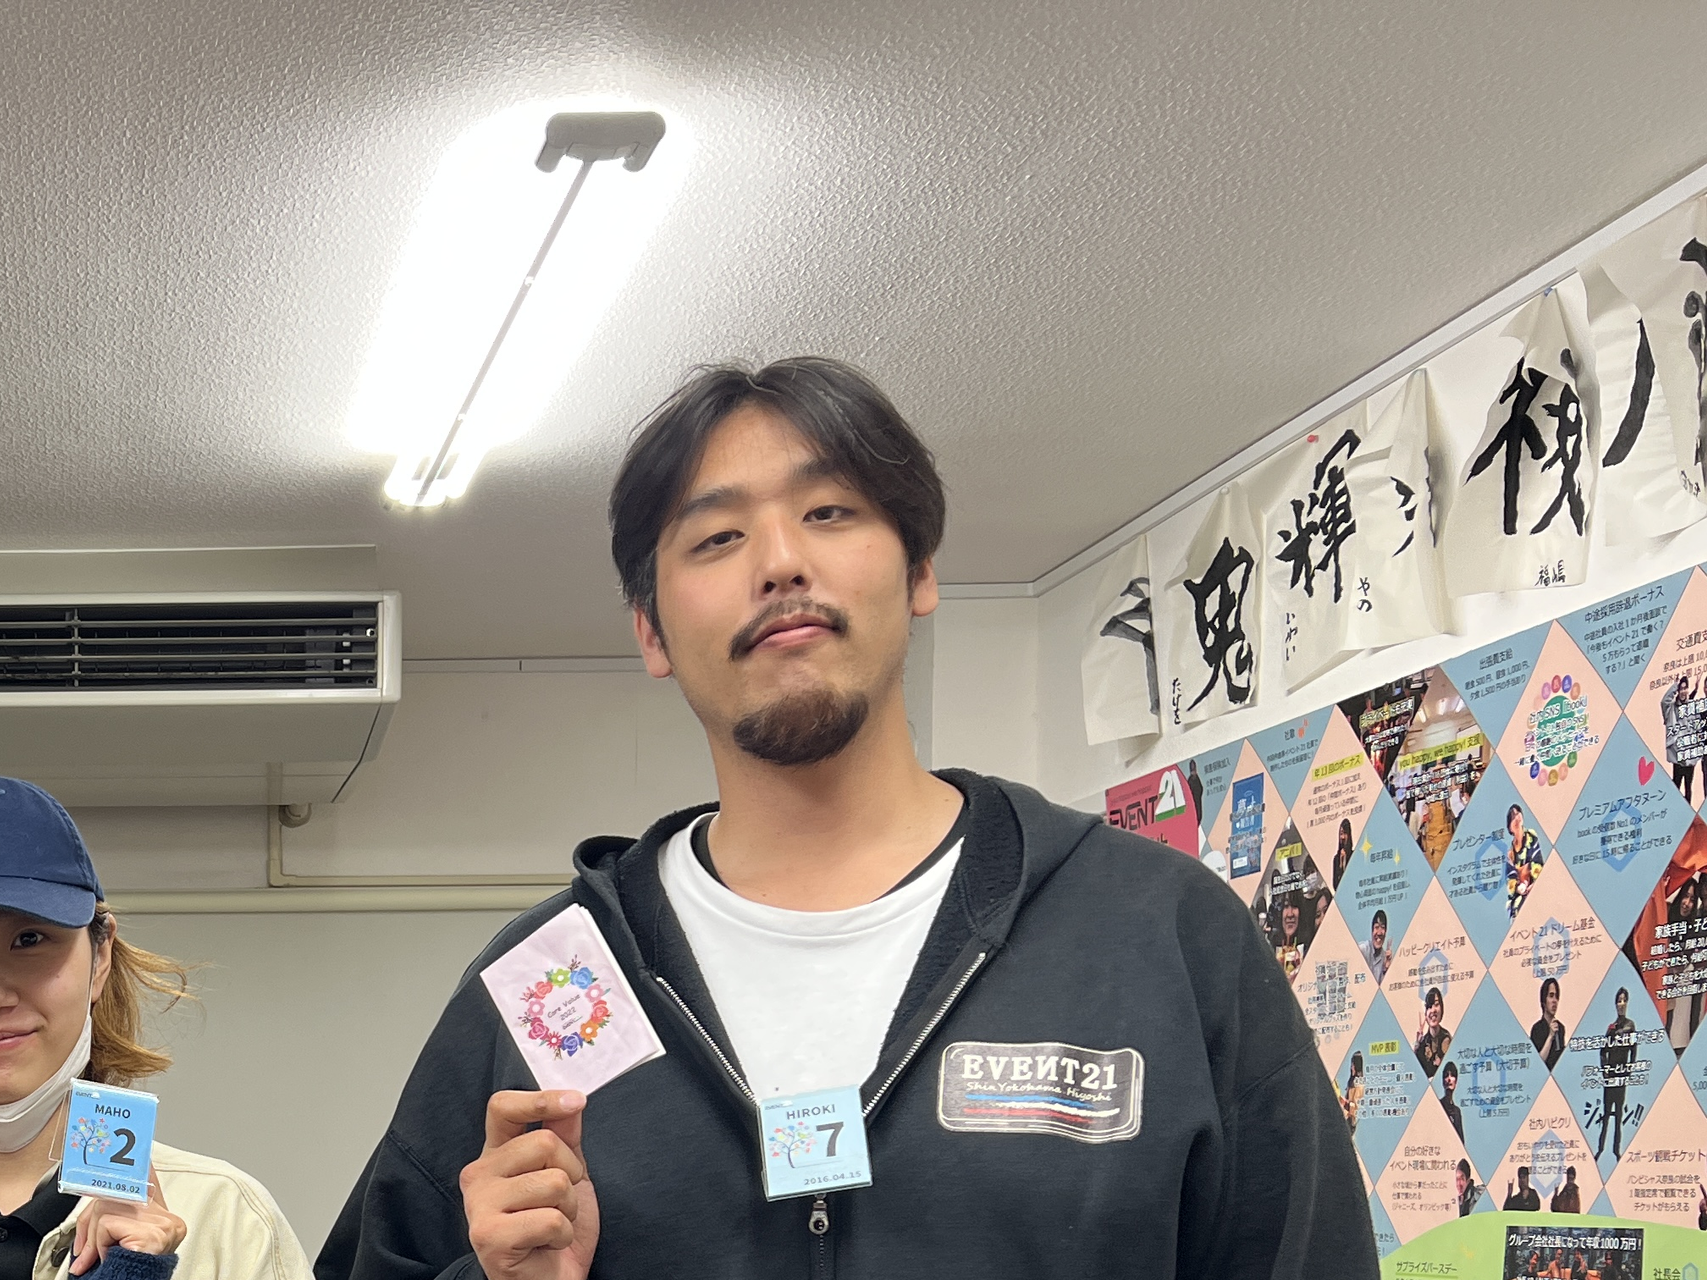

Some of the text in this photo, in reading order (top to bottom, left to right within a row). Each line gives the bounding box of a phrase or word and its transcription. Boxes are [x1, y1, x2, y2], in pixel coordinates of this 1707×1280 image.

[1357, 577, 1373, 612] やの
[1579, 789, 1666, 820] プレミアムアフタヌーン
[547, 1004, 561, 1019] Core
[560, 1007, 577, 1021] 2022
[962, 1055, 1117, 1090] EVENT21
[966, 1081, 1112, 1102] Shin Yokohama Hiyoshi
[95, 1104, 131, 1118] MAHO
[786, 1104, 836, 1120] HIROKI
[110, 1128, 135, 1166] 2
[816, 1121, 844, 1157] 7
[804, 1171, 861, 1185] 2016.04.15
[1653, 1267, 1681, 1280] 社長会
